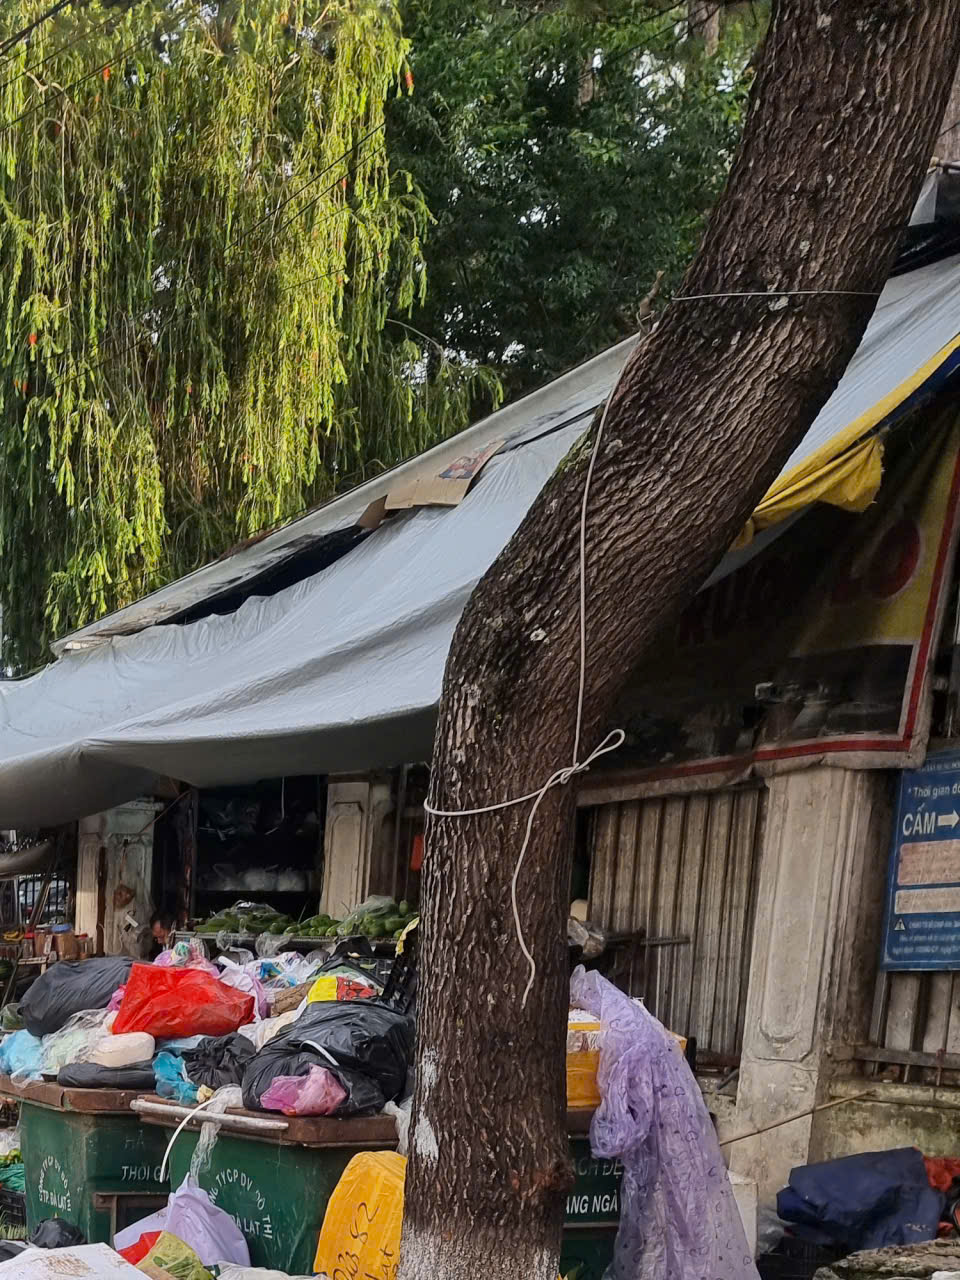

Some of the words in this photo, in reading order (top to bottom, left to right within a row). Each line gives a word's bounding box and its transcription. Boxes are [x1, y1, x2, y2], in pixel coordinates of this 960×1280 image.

[903, 802, 936, 836] CẤM
[602, 1159, 624, 1179] ĐẸ
[592, 1189, 618, 1213] NGÀ
